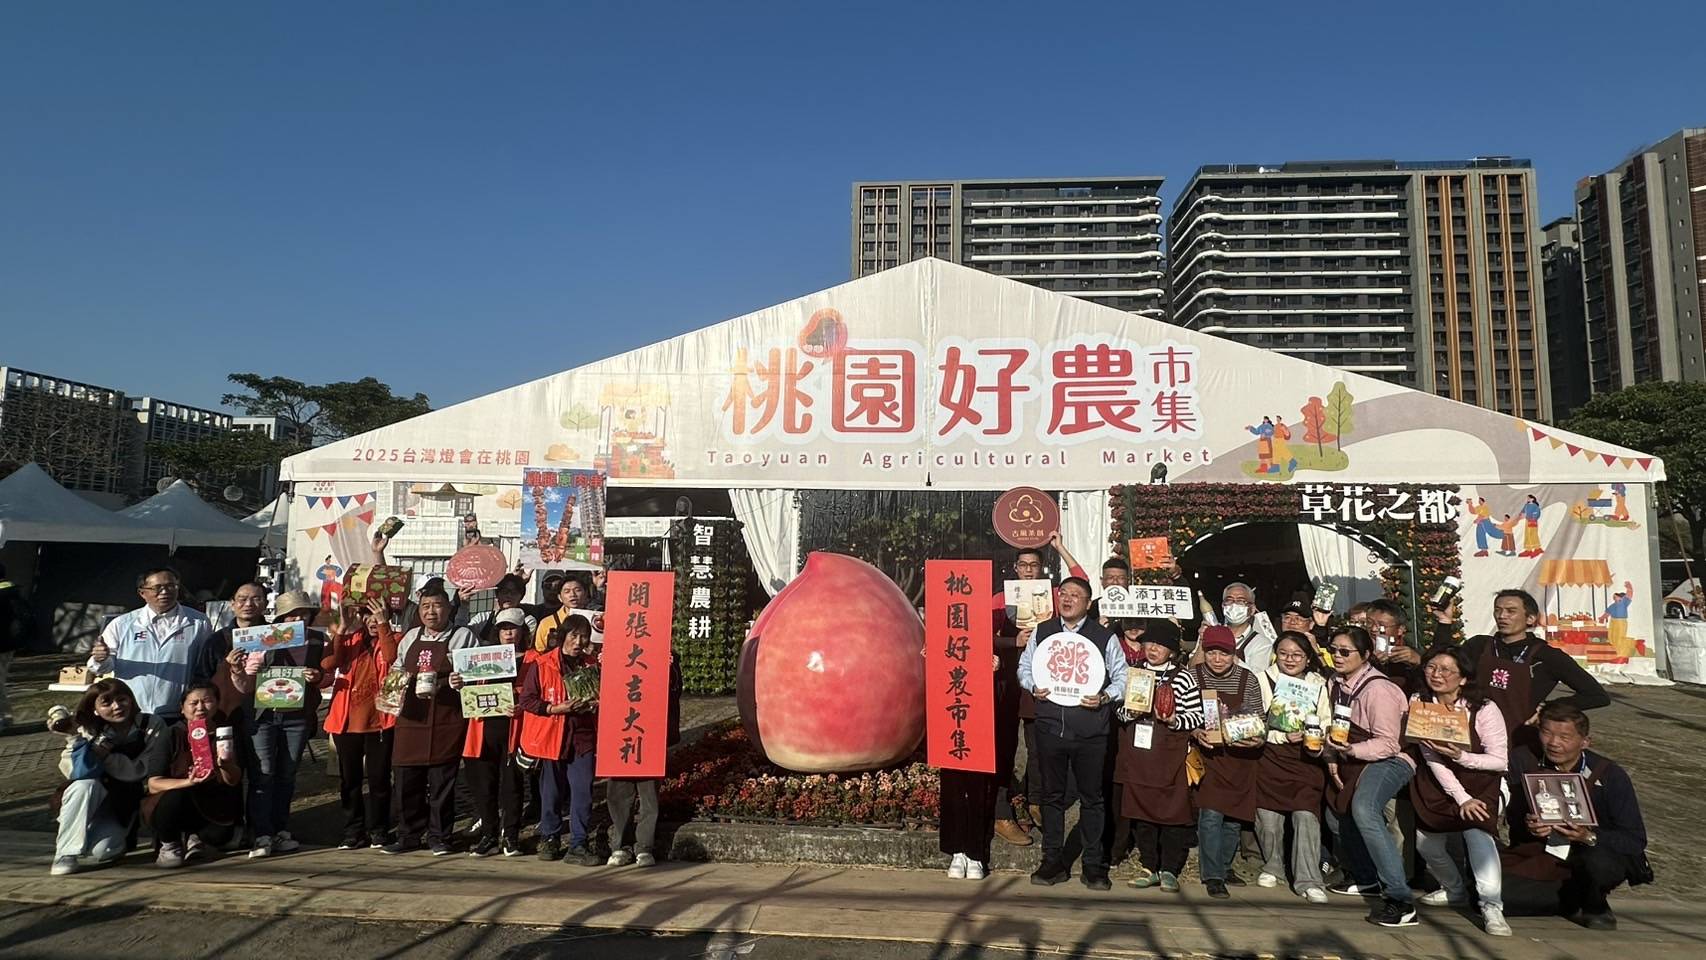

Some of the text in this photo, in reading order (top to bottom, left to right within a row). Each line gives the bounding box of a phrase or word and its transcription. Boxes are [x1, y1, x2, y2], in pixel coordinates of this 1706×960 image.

[721, 342, 1197, 436] 桃園好農 市集
[352, 448, 530, 466] 2025台灣燈會在桃園
[707, 449, 1209, 468] Taoyuan Agricultural Market
[1297, 485, 1461, 524] 草花之都
[688, 523, 714, 640] 智慧農耕
[1135, 588, 1188, 602] 添丁養生
[1137, 603, 1177, 615] 黑木耳
[619, 581, 651, 766] 開張大吉大利
[944, 571, 973, 760] 桃園好農市集
